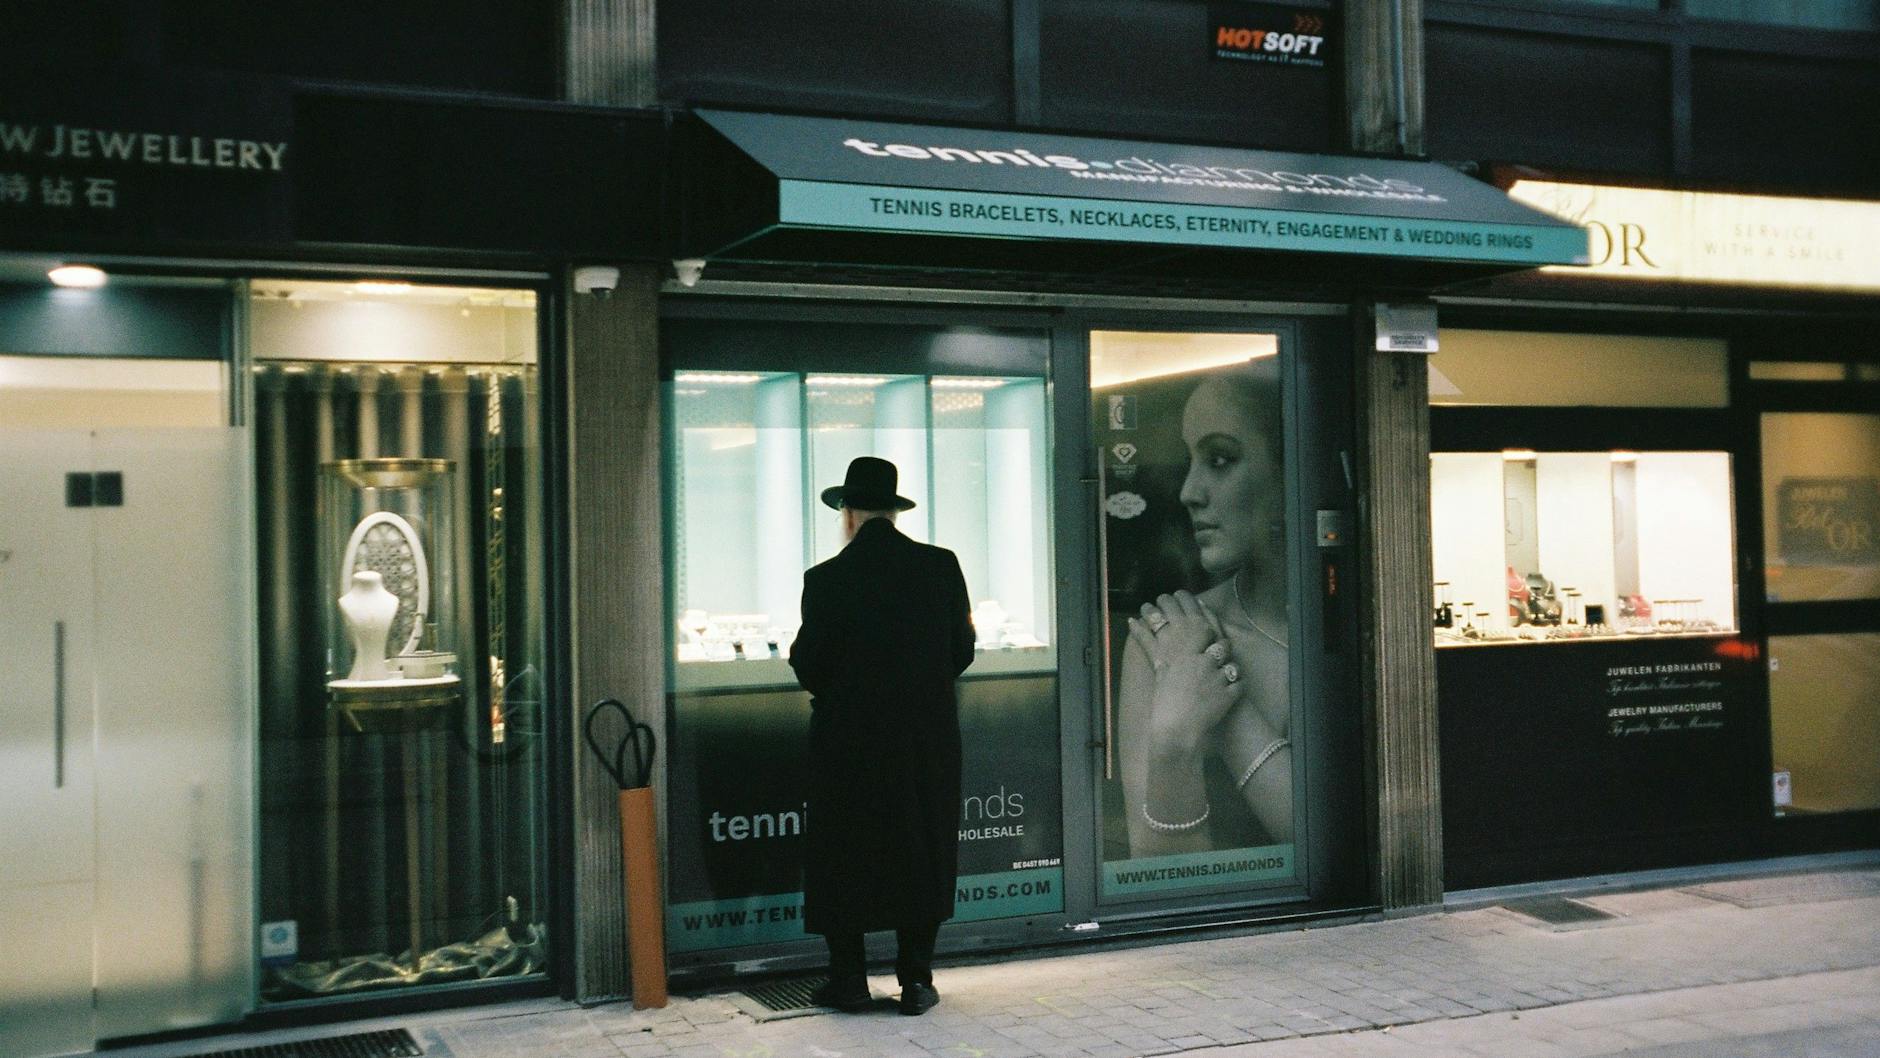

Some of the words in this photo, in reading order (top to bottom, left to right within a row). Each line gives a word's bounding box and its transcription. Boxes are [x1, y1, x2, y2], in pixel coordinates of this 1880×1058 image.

[1217, 26, 1324, 55] HOTSOFT
[47, 124, 288, 171] JEWELLERY
[869, 197, 943, 217] TENNIS
[950, 203, 1064, 226] BRACELETS,
[1071, 209, 1181, 232] NECKLACES,
[1187, 216, 1272, 236] ETERNITY,
[1277, 221, 1390, 242] ENGAGEMENT
[1393, 227, 1404, 242] &
[1407, 228, 1483, 247] WEDDING
[1488, 232, 1534, 249] RINGS
[1607, 665, 1653, 677] JUWELEN
[1655, 662, 1722, 674] FABRIKANTEN
[1608, 706, 1648, 718] JEWELRY
[1649, 702, 1723, 715] MANUFACTURERS
[1116, 856, 1285, 885] WWW.TENNIS.DIAMONDS
